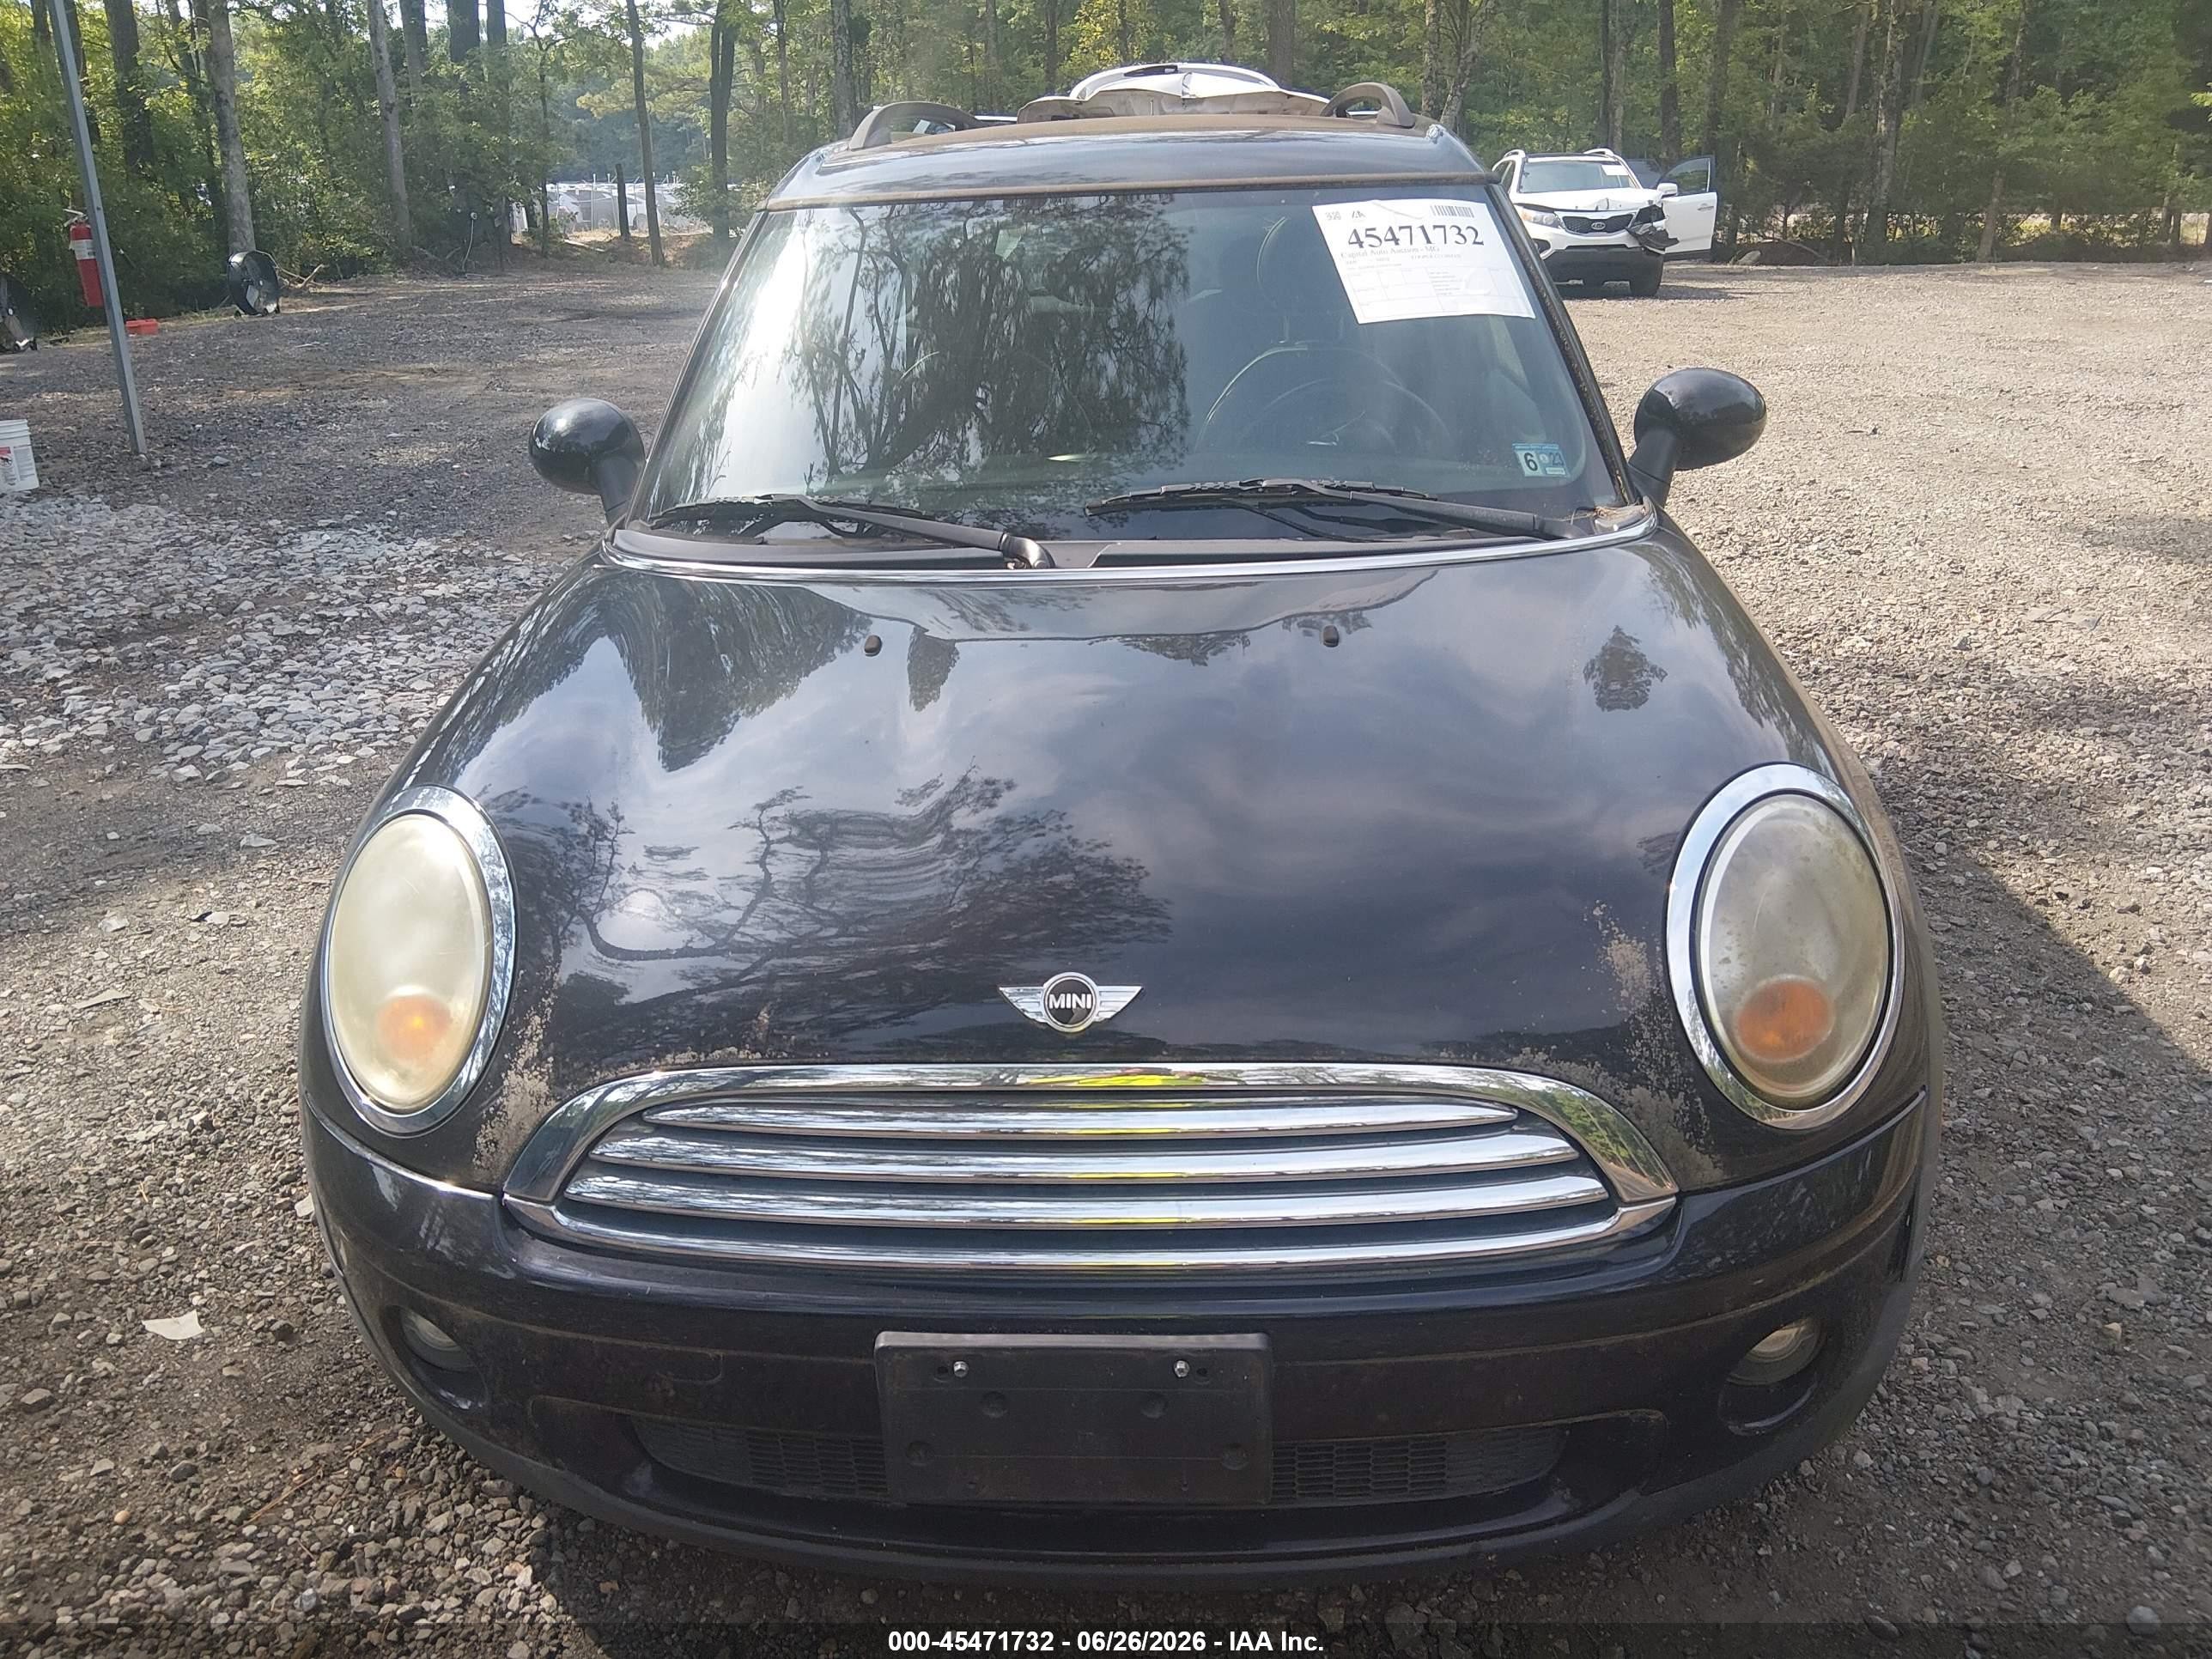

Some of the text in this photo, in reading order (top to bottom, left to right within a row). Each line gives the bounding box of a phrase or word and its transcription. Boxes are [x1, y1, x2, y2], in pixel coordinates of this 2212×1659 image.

[1348, 224, 1485, 249] 45471732
[1523, 452, 1538, 471] 6
[1048, 994, 1092, 1009] MINI
